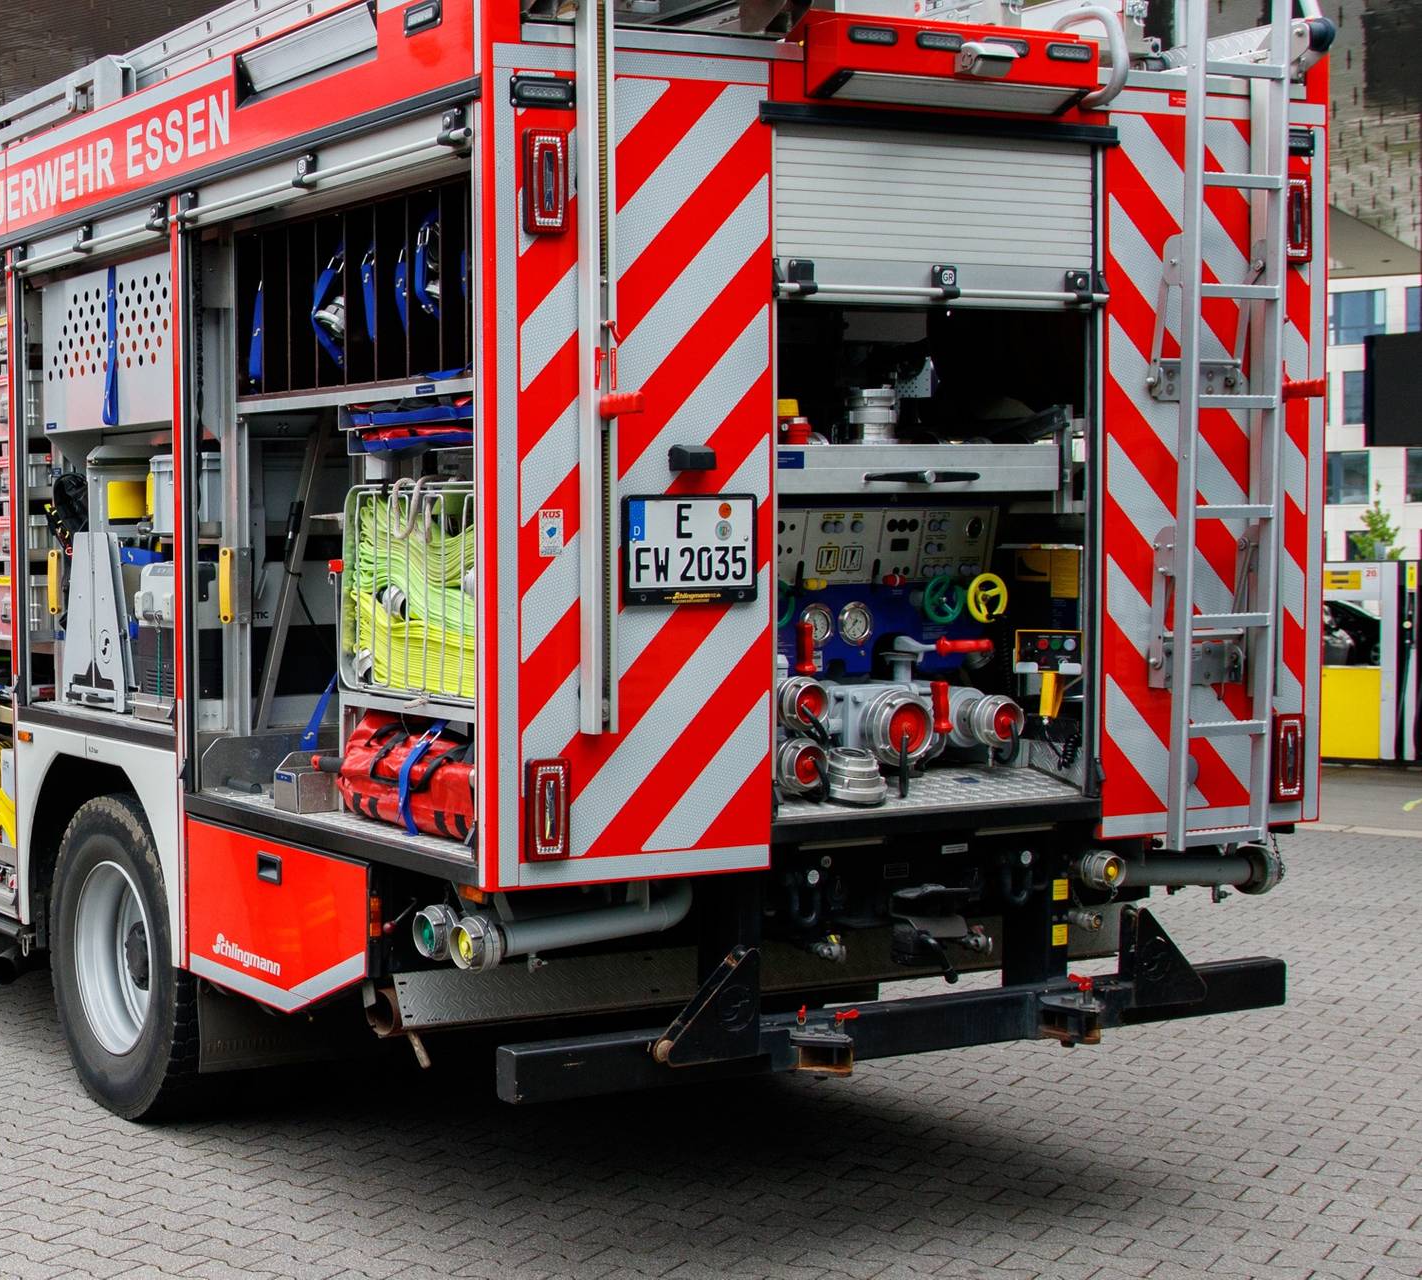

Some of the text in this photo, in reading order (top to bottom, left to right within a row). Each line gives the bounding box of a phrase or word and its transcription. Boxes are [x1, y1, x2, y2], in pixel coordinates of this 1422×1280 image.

[126, 89, 230, 179] ESSEN
[633, 525, 641, 536] D
[676, 503, 692, 538] E
[635, 546, 747, 582] FW 2035
[212, 933, 281, 976] Schlingmann
